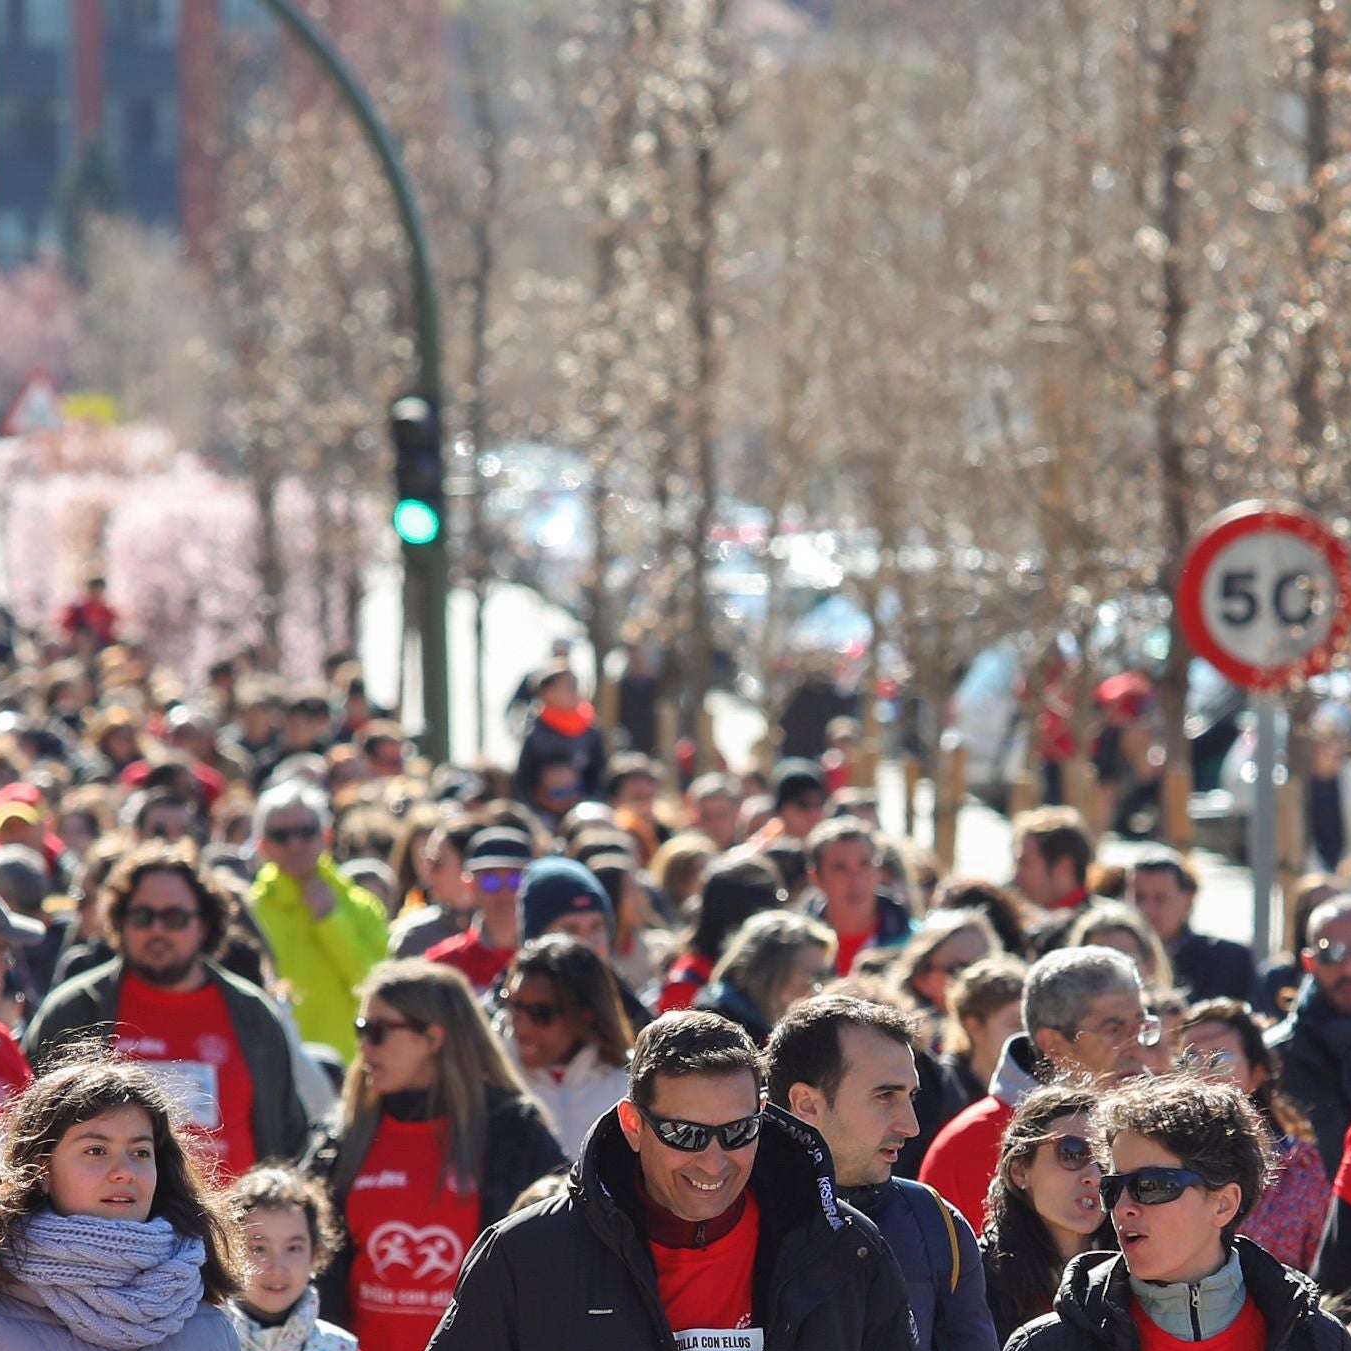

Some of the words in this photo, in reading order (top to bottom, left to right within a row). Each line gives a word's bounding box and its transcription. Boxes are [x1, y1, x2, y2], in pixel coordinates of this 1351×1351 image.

[1221, 571, 1317, 627] 50
[676, 1336, 699, 1351] RILLA
[701, 1336, 720, 1349] CON
[722, 1336, 751, 1349] ELLOS
